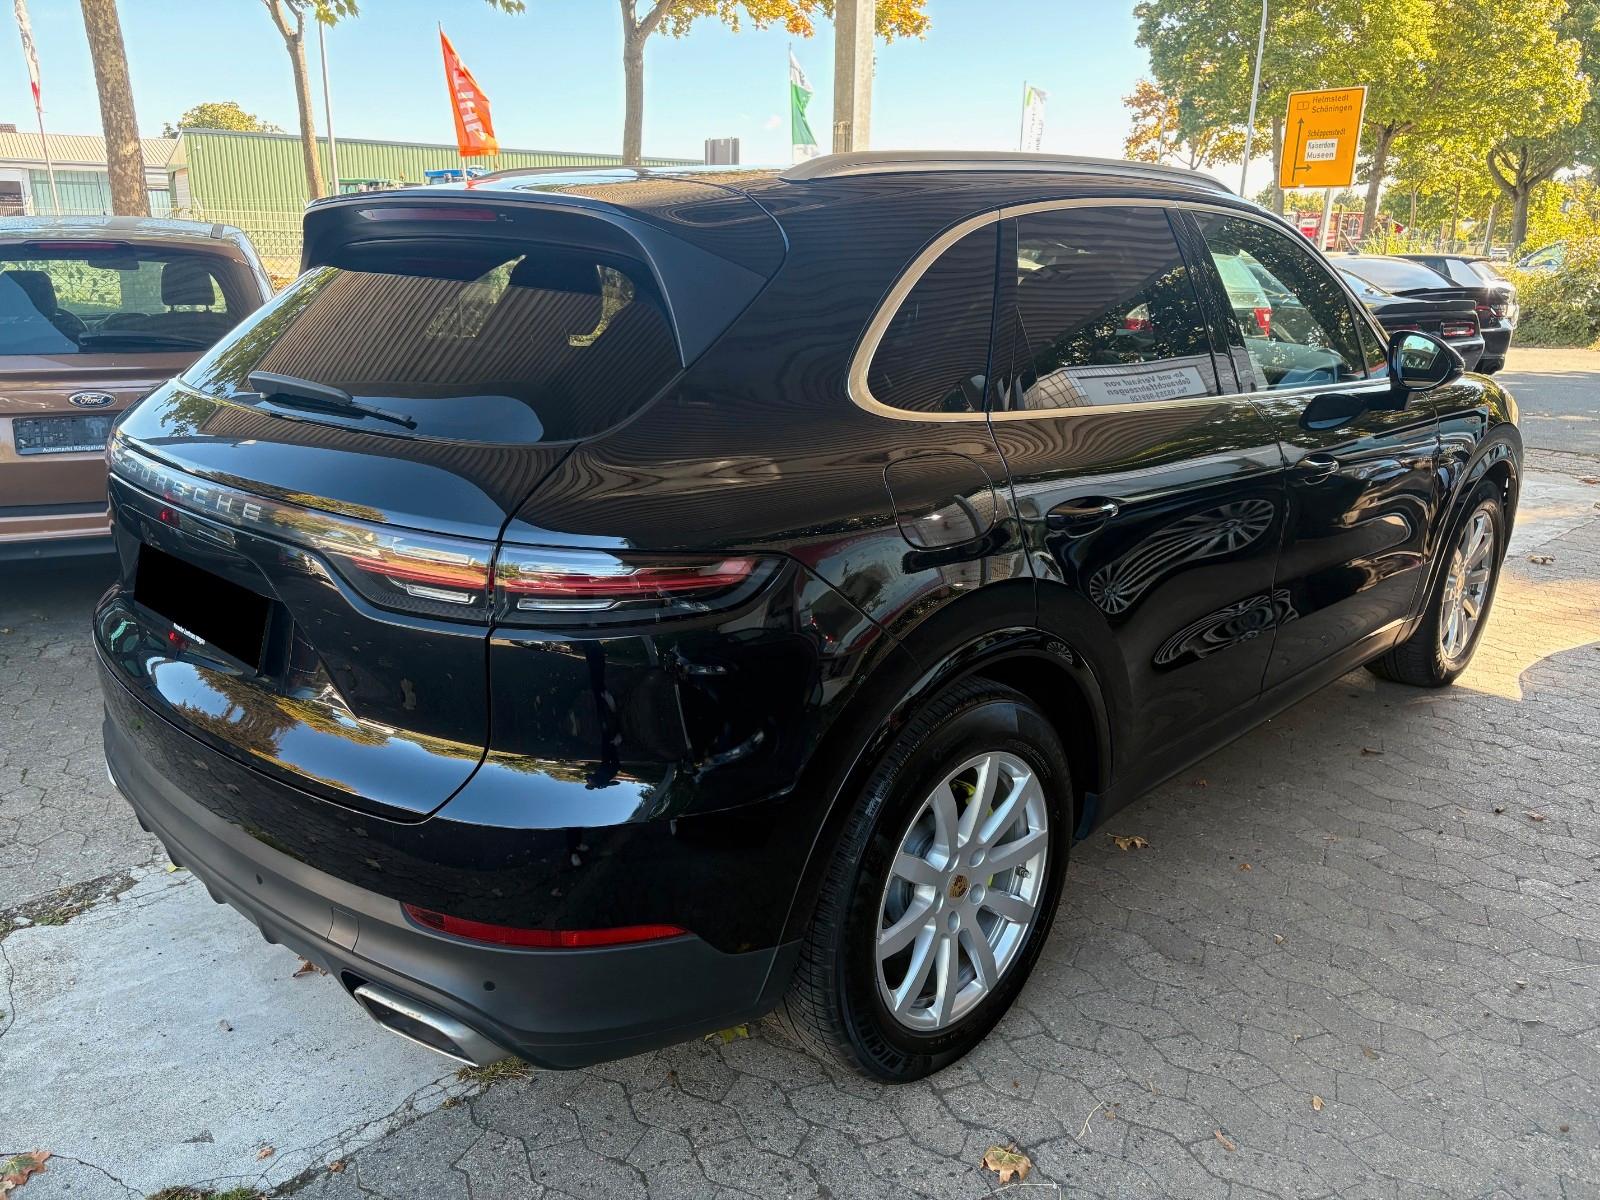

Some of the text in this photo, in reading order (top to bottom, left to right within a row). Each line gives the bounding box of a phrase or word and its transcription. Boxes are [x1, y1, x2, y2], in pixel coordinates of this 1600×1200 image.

[1312, 94, 1349, 104] Helmstedt
[1311, 105, 1353, 114] Schöningen
[1307, 128, 1346, 138] Schöppenstedt
[1308, 141, 1335, 149] Kaiserdom
[1306, 151, 1334, 159] Museen
[80, 394, 105, 405] Ford
[74, 444, 106, 452] Königslutte
[126, 459, 263, 523] PORSCHE
